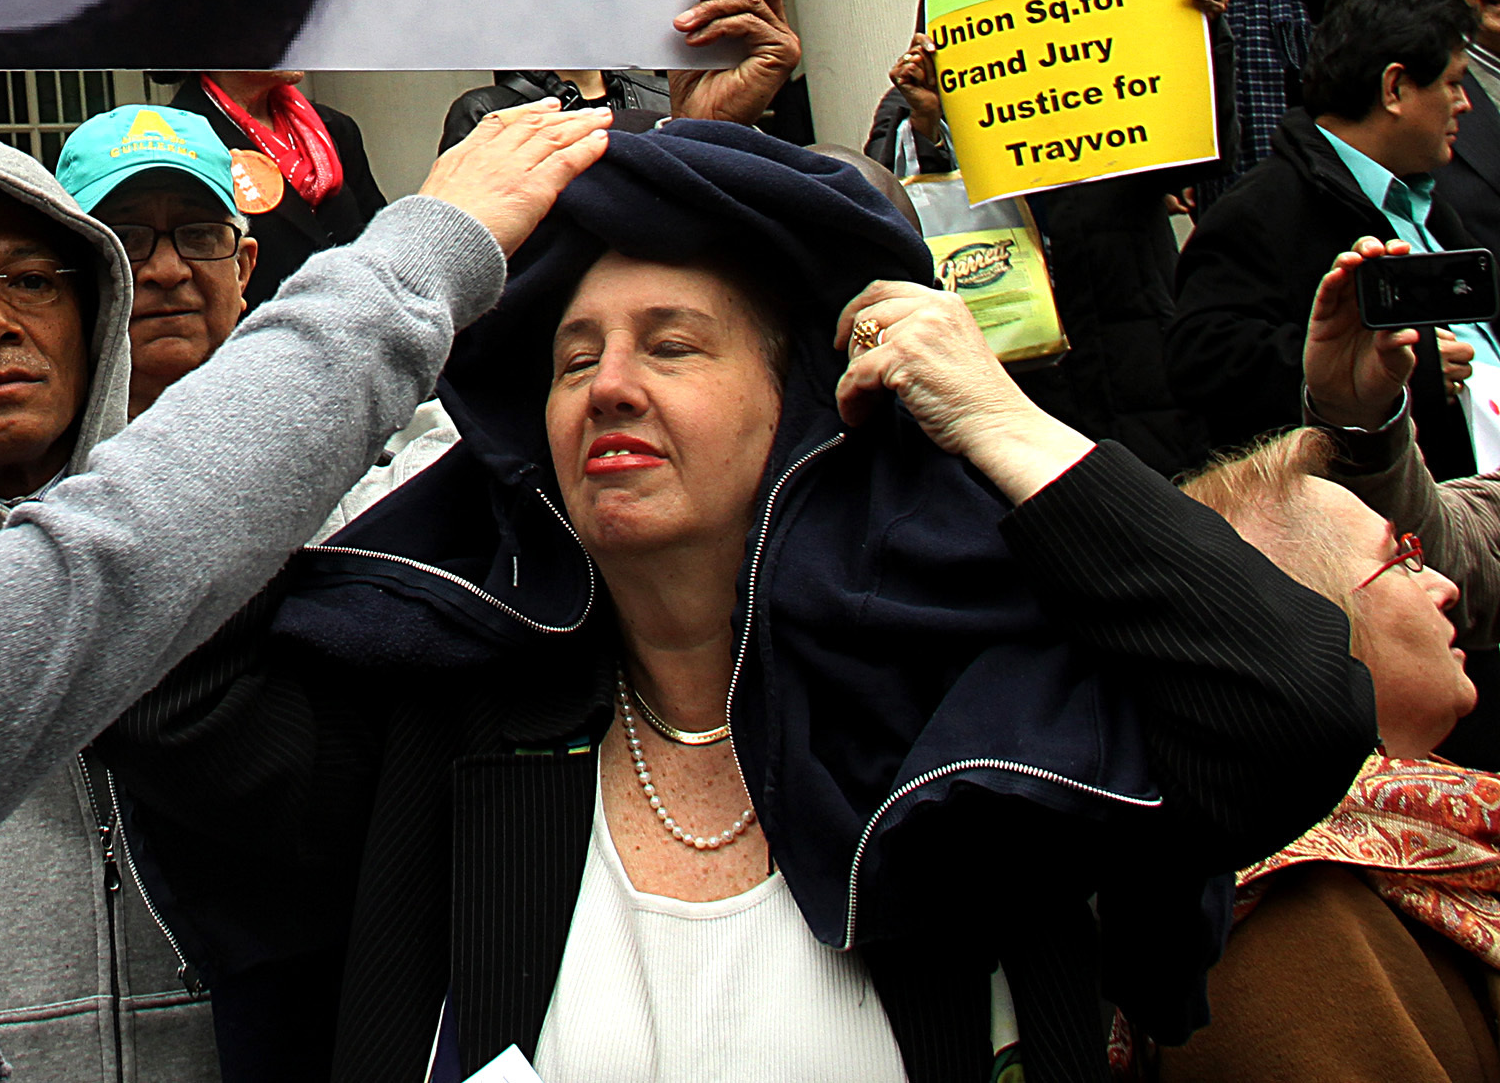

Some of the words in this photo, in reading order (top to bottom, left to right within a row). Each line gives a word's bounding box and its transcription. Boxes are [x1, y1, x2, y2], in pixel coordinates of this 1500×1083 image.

[932, 11, 1015, 51] Union
[940, 49, 1027, 93] Grand
[1038, 37, 1113, 68] Jury
[978, 86, 1103, 128] Justice
[1113, 75, 1161, 100] for
[1005, 124, 1148, 166] Trayvon
